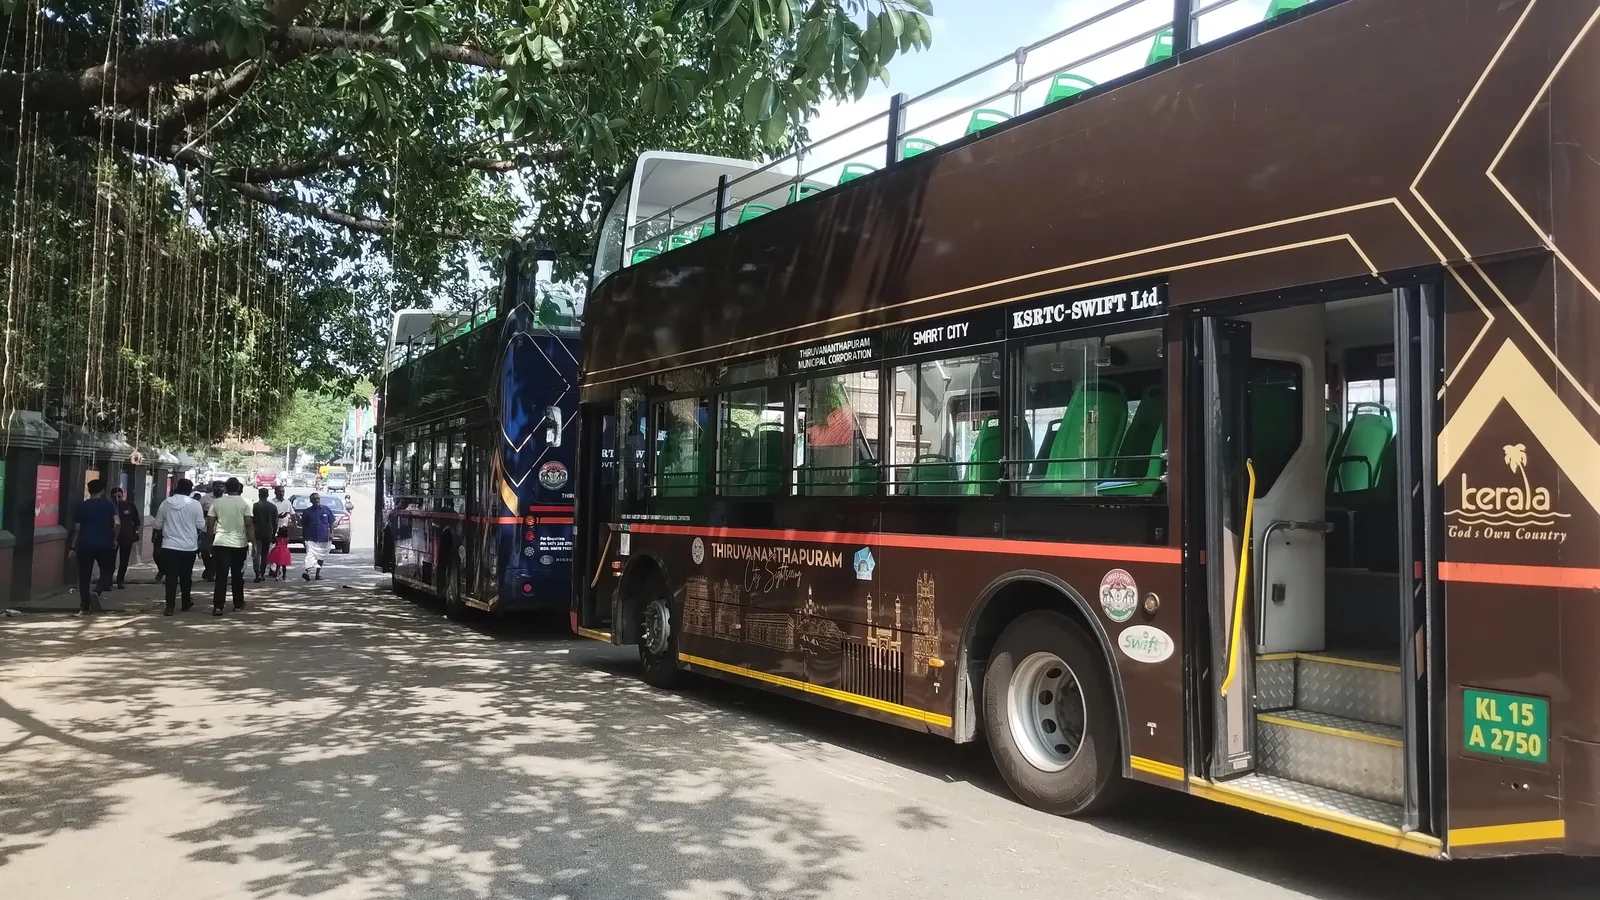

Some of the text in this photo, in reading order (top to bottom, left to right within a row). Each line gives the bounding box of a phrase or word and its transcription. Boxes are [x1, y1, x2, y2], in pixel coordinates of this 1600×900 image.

[1012, 287, 1163, 330] KSRTC-SWIFT Ltd.
[913, 322, 969, 346] SMART CITY
[798, 349, 872, 369] MUNICIPAL CORPORATION
[799, 337, 871, 358] THIRUVANANTHAPURAM
[1461, 464, 1551, 511] kerala
[1483, 527, 1511, 539] Own
[1515, 528, 1567, 544] Country
[711, 543, 843, 568] THIRUVANANTHAPURAM
[1475, 697, 1535, 726] KL 15
[1468, 724, 1541, 757] A 2750
